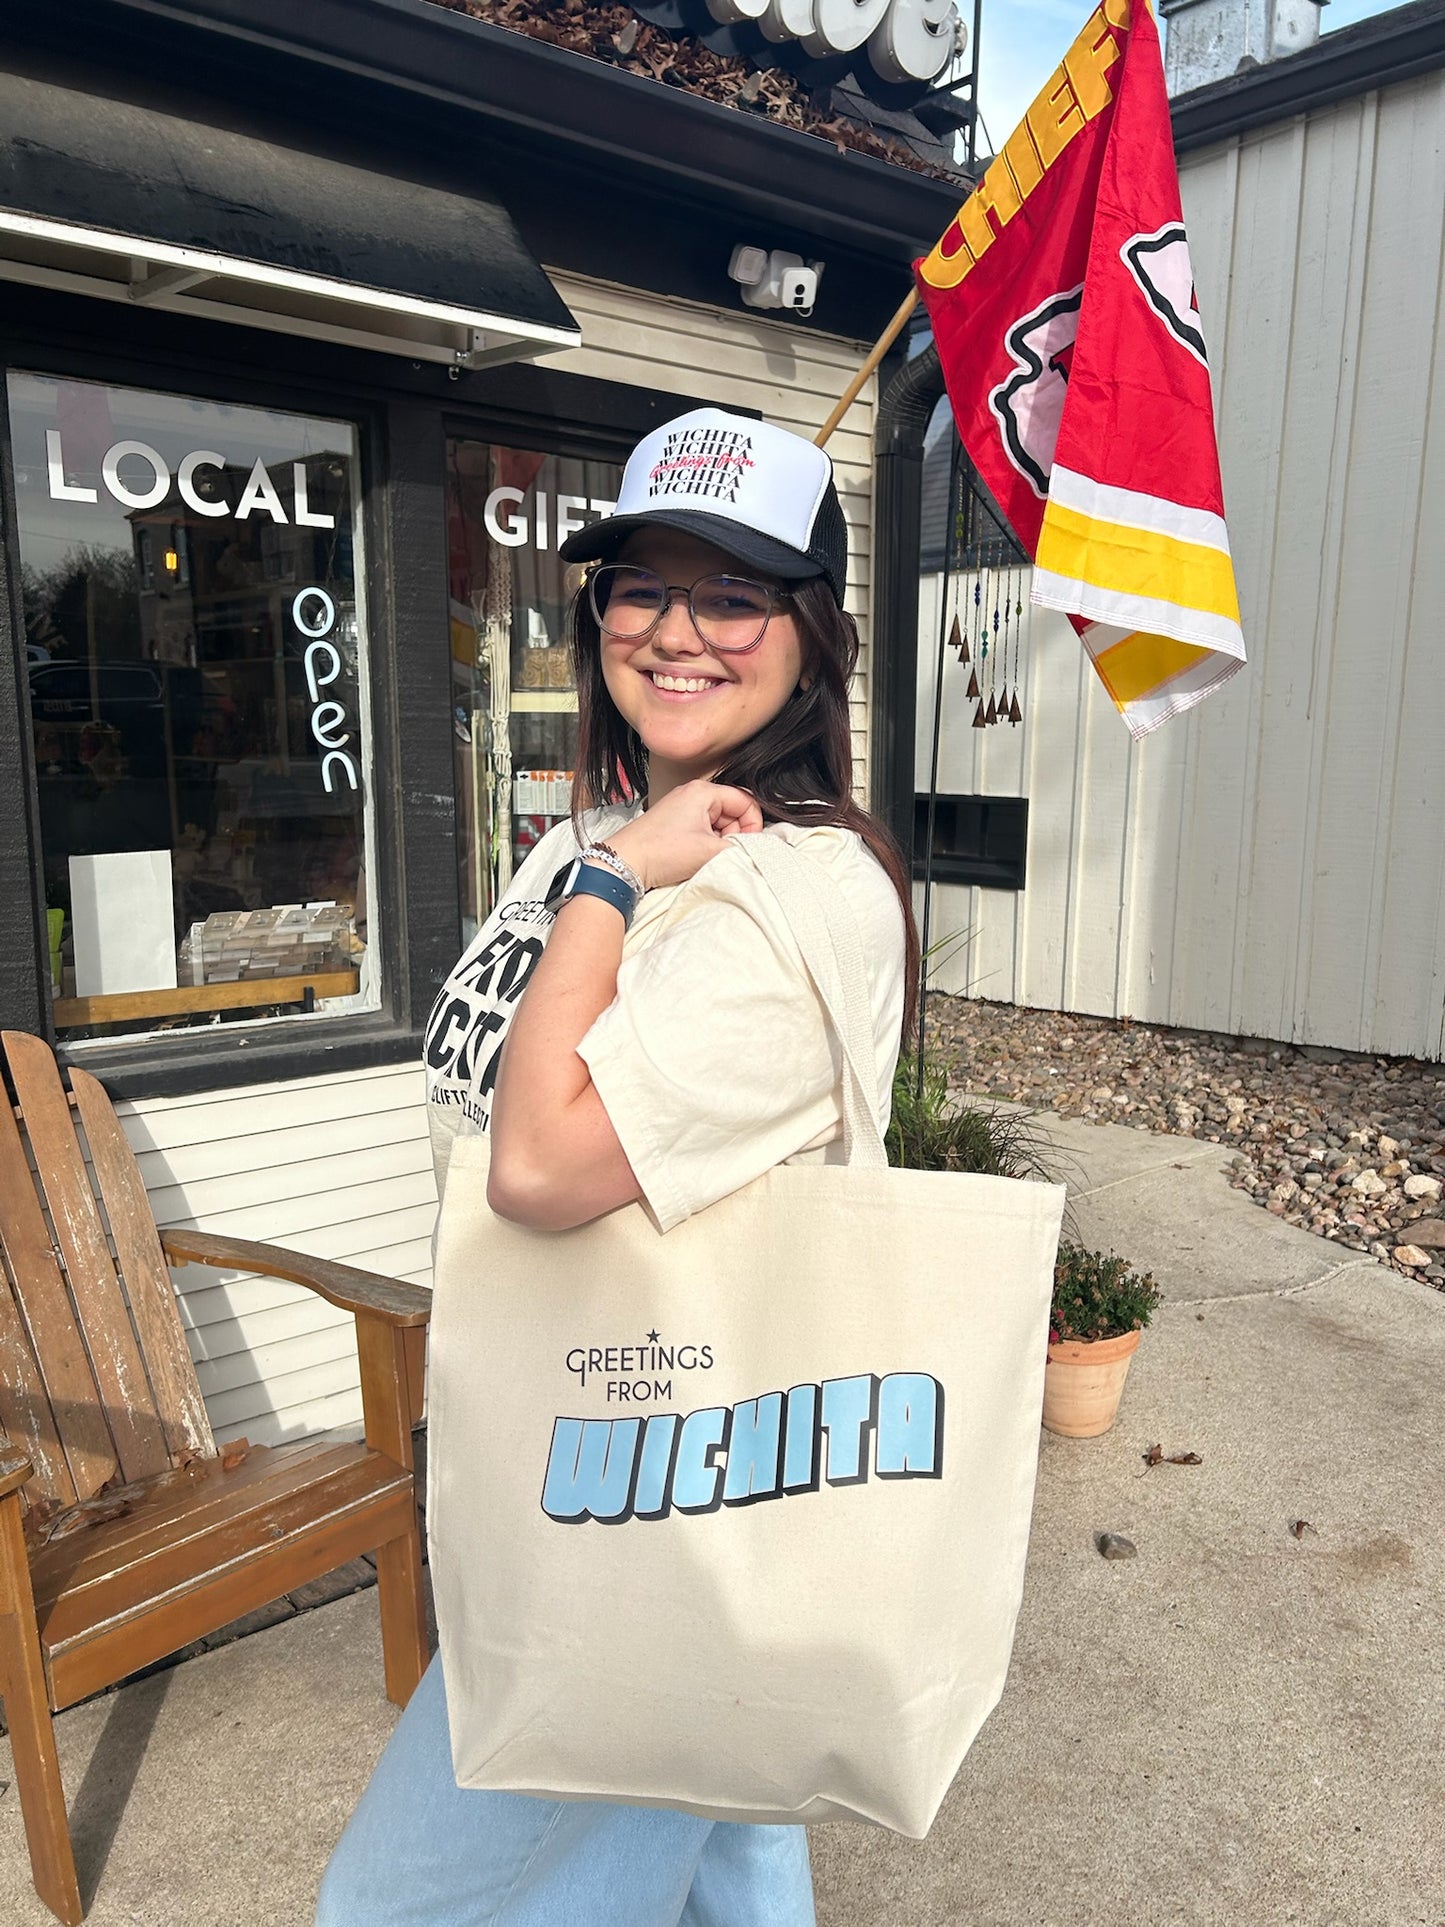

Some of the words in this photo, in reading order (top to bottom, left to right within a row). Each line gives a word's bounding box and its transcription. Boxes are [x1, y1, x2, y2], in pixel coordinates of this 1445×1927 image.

[668, 428, 753, 450] WICHITA
[663, 442, 748, 460] WICHITA
[649, 455, 712, 479] Greetings
[715, 452, 757, 469] from
[45, 429, 335, 530] LOCAL
[655, 469, 741, 488] WICHITA
[649, 482, 737, 503] WICHITA
[565, 1343, 715, 1388] GREETINGS
[606, 1380, 673, 1402] FROM
[540, 1371, 945, 1526] WICHITA
